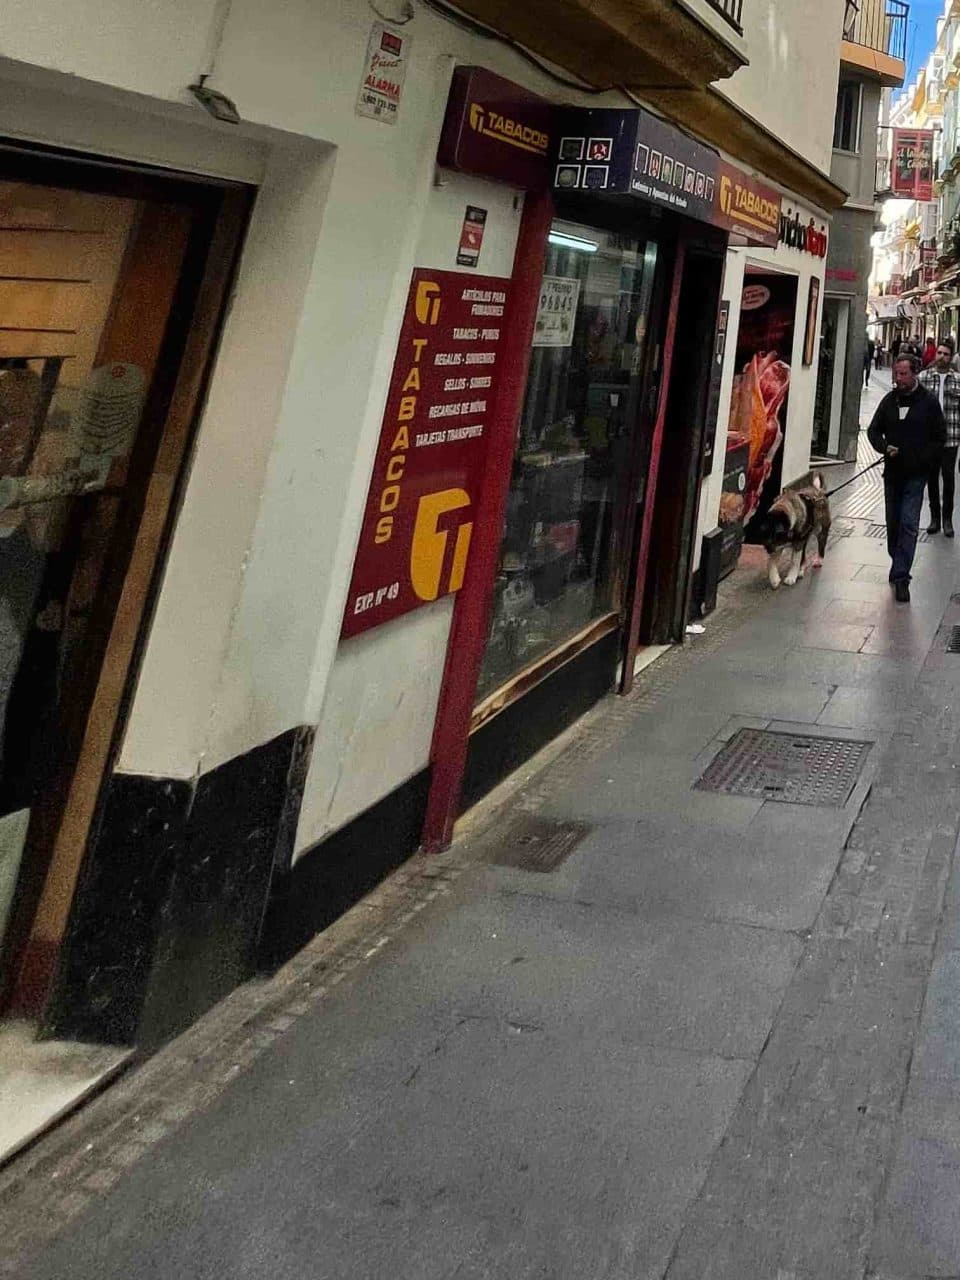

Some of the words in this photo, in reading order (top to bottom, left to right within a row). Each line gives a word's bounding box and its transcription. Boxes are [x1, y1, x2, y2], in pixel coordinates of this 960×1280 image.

[488, 111, 549, 150] TABACOS
[734, 185, 779, 224] TABACOS
[434, 352, 462, 366] REGALOS
[443, 377, 467, 391] SELLOS
[428, 403, 461, 419] RECARGAS
[460, 402, 470, 415] DE
[374, 338, 429, 545] TABACOS
[415, 430, 447, 447] TARJETAS
[446, 424, 484, 442] TRANSPORTE
[354, 591, 374, 615] EXP.
[386, 581, 400, 600] 49
